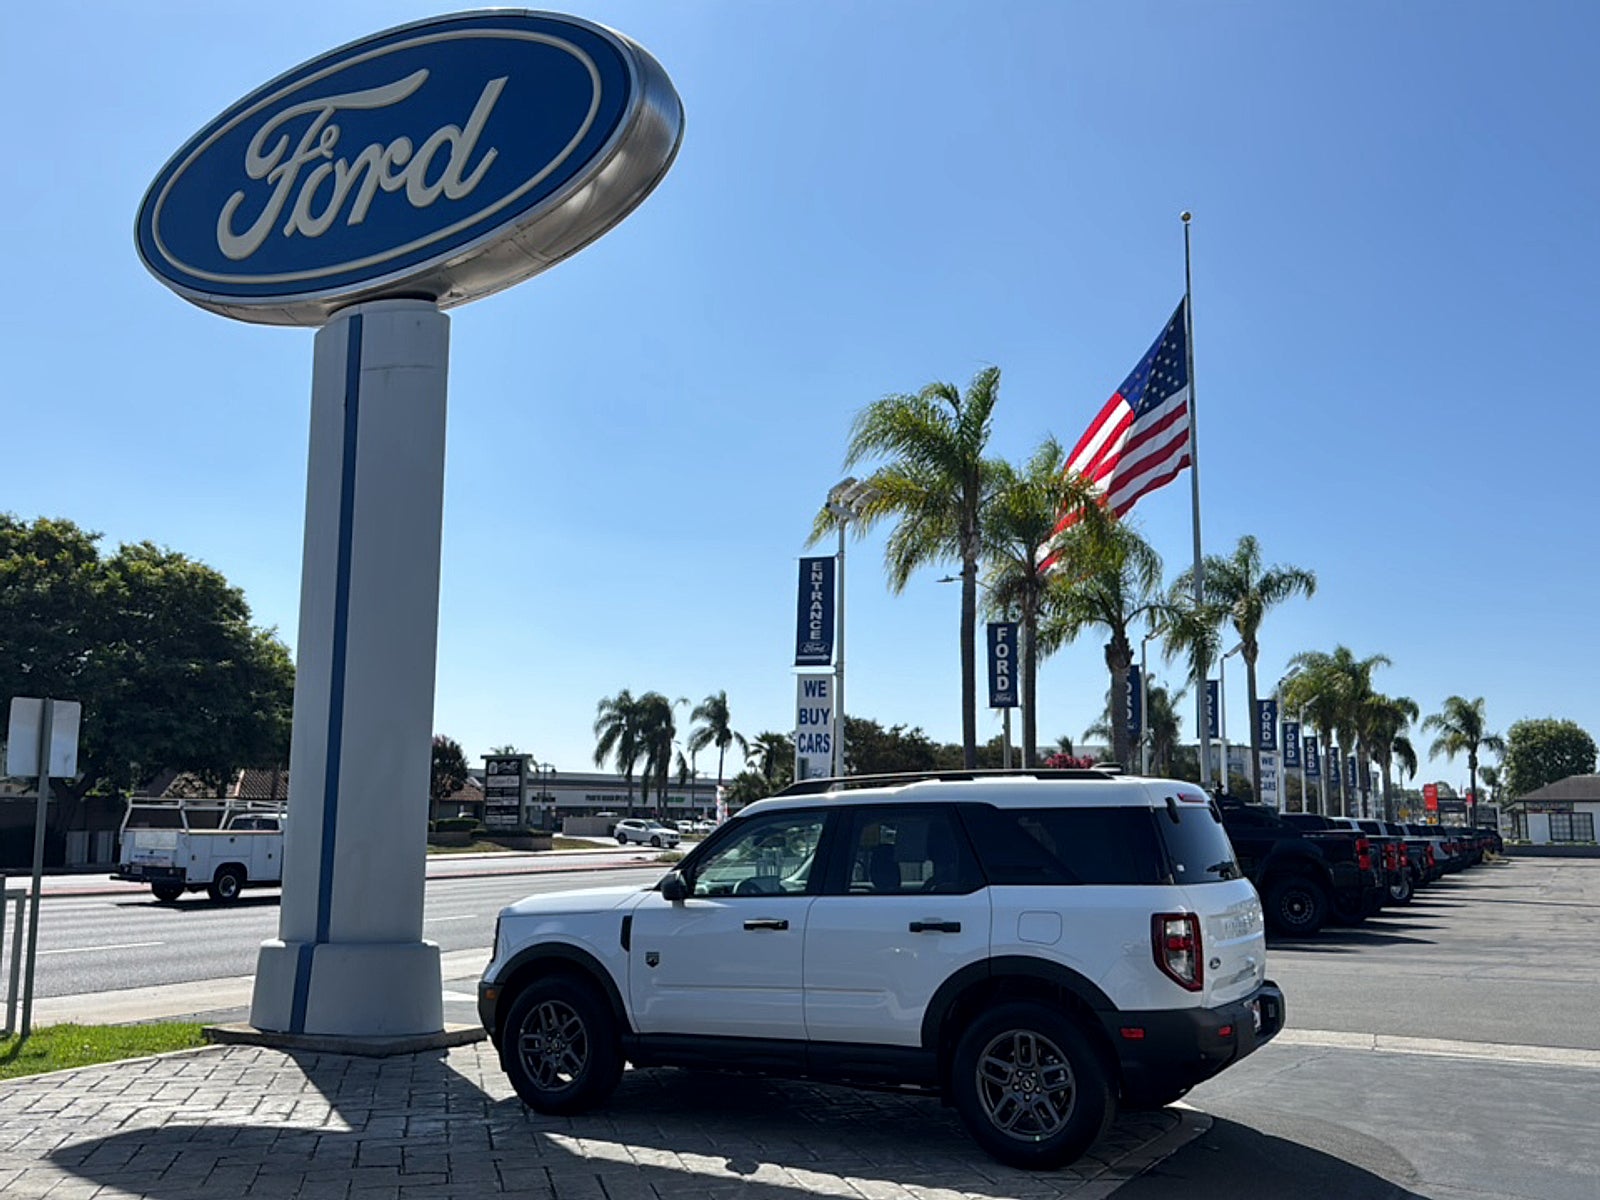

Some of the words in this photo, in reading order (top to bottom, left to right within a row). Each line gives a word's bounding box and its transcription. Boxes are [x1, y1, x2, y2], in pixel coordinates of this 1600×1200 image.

[216, 68, 508, 260] Ford
[810, 562, 823, 640] ENTRANCE
[802, 642, 826, 653] Ford
[995, 627, 1009, 691] FORD
[804, 680, 827, 697] WE
[799, 708, 831, 725] BUY
[1262, 702, 1271, 740] FORD
[798, 733, 831, 753] CARS
[1286, 725, 1295, 757] FORD
